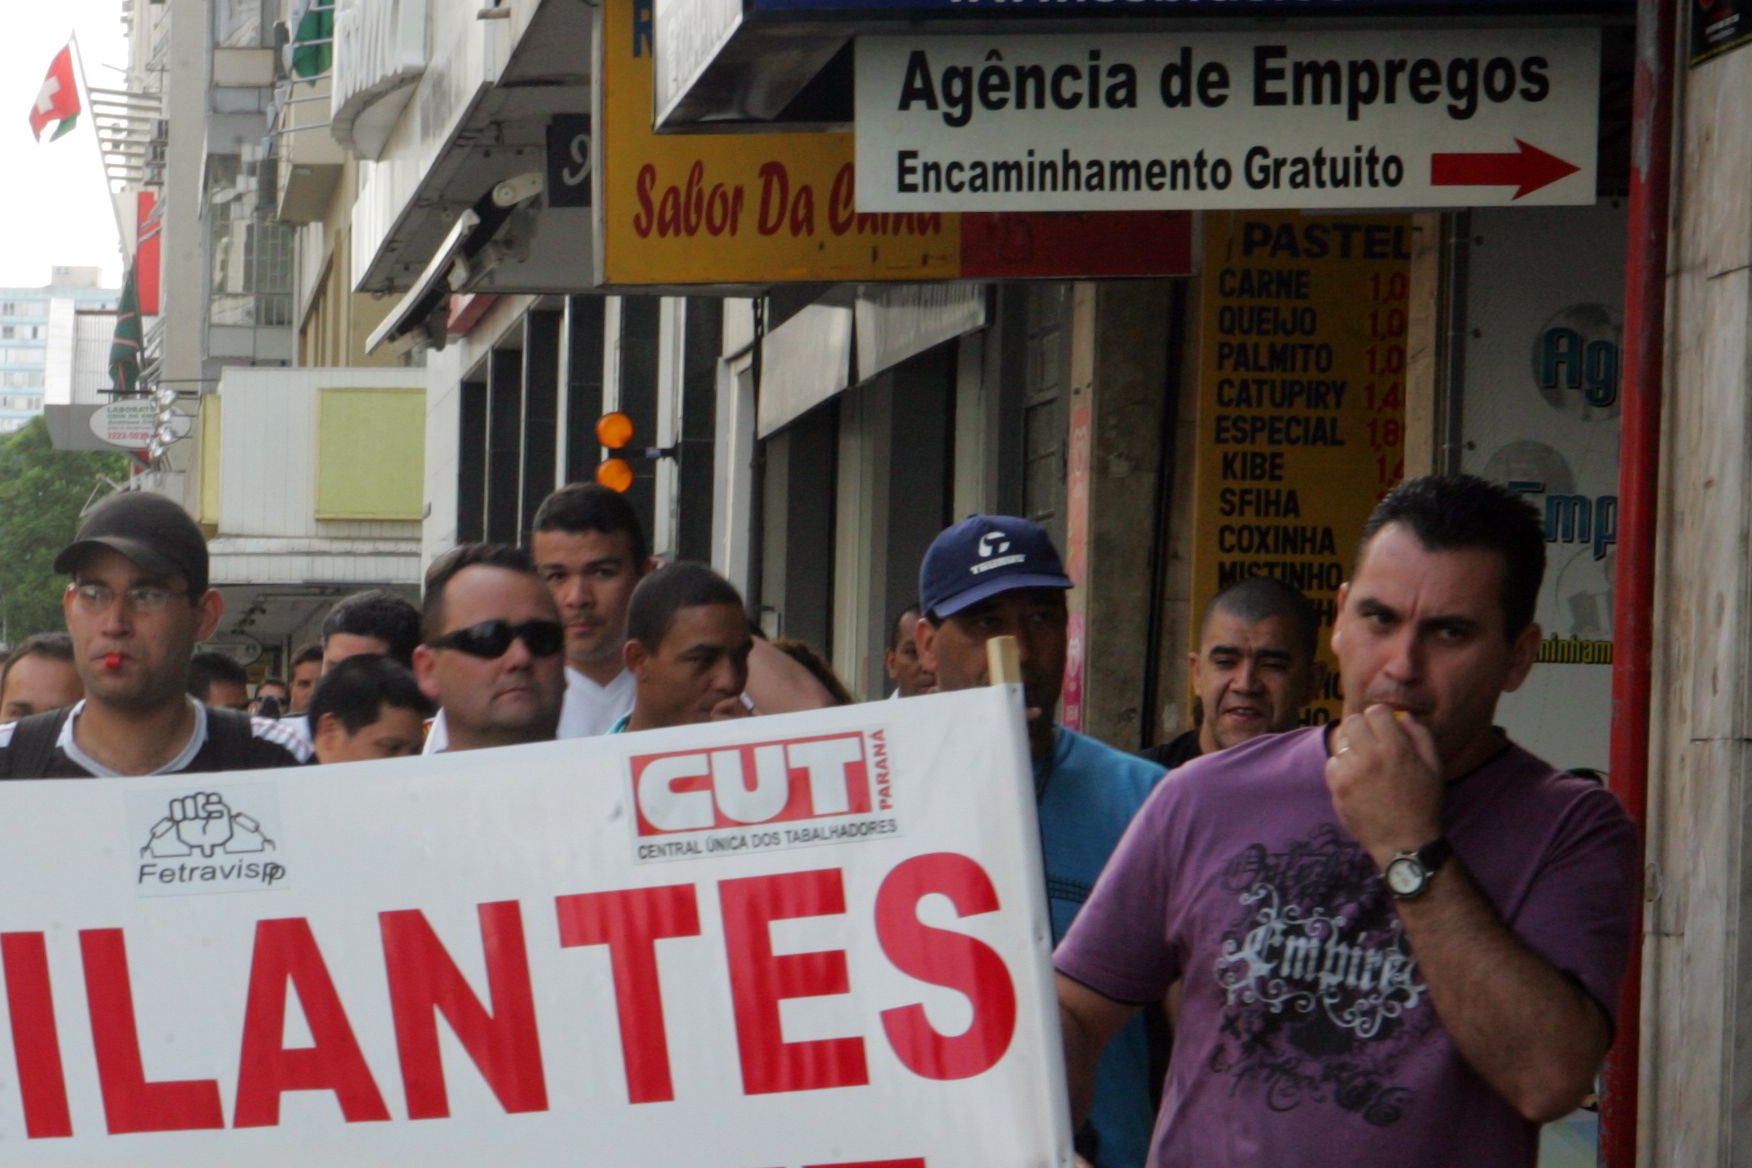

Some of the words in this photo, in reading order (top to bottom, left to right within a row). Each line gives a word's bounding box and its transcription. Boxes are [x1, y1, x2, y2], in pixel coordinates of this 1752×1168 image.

[897, 49, 1137, 127] Agência
[1159, 46, 1230, 108] de
[1253, 45, 1550, 121] Empregos
[897, 148, 1232, 193] Encaminhamento
[1244, 144, 1404, 190] Gratuito
[633, 159, 744, 239] Sabor
[758, 161, 814, 237] Da
[1242, 222, 1412, 259] PASTEL
[1218, 267, 1310, 299] CARNE
[1369, 271, 1408, 304] 1,0
[1218, 306, 1317, 336] QUEIJO
[1368, 308, 1407, 341] 1,0
[1216, 342, 1333, 373] PALMITO
[1366, 345, 1406, 376] 1,0
[1544, 328, 1620, 407] Ag
[1216, 379, 1347, 410] CATUPIRY
[1364, 382, 1404, 413] 1,4
[1215, 415, 1346, 446] ESPECIAL
[1366, 417, 1404, 450] 1,8
[1222, 452, 1285, 482] KIBE
[1219, 488, 1301, 518] SFIHA
[1218, 524, 1336, 555] COXINHA
[637, 736, 864, 832] CUT
[868, 728, 894, 811] PARANÁ
[637, 840, 702, 861] CENTRAL
[705, 834, 748, 854] ÚNICA
[751, 832, 782, 849] DOS
